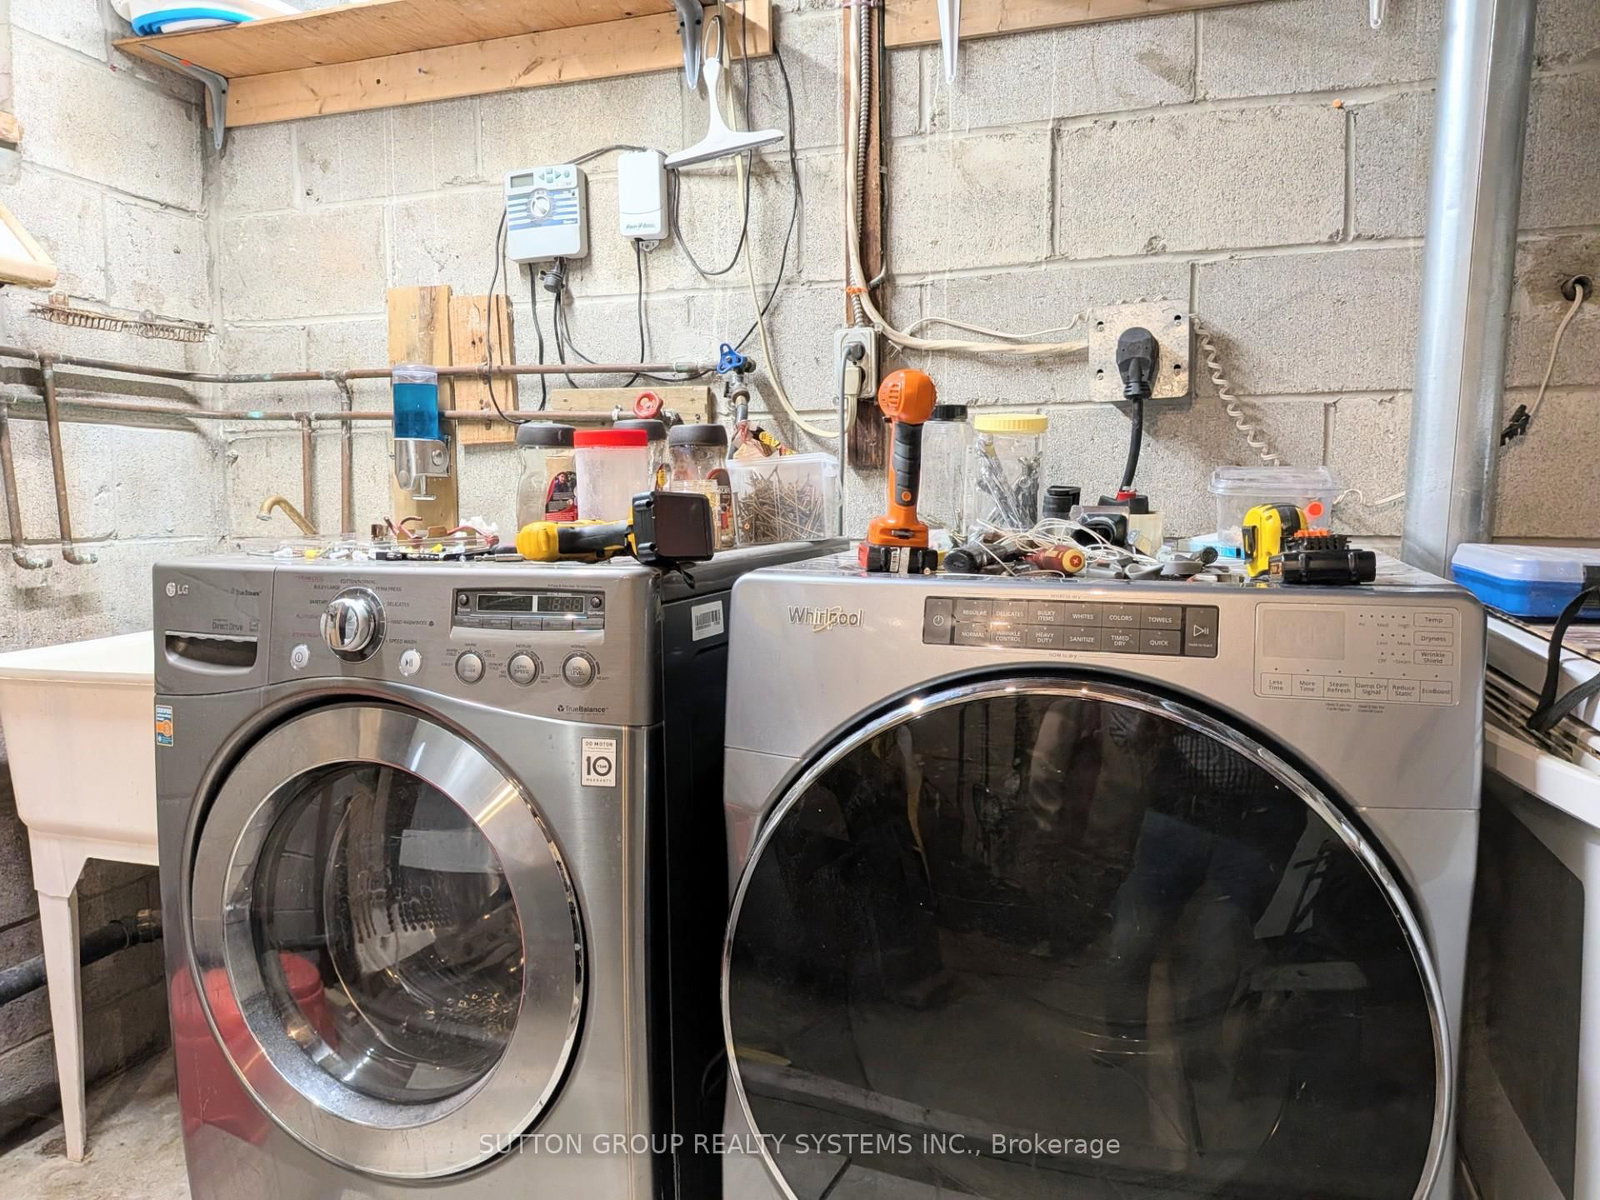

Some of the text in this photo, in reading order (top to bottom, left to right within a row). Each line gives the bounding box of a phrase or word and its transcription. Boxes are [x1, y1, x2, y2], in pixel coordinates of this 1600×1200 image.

[788, 605, 865, 631] Whirlpool
[1421, 635, 1447, 643] Dryness
[586, 756, 612, 777] 10
